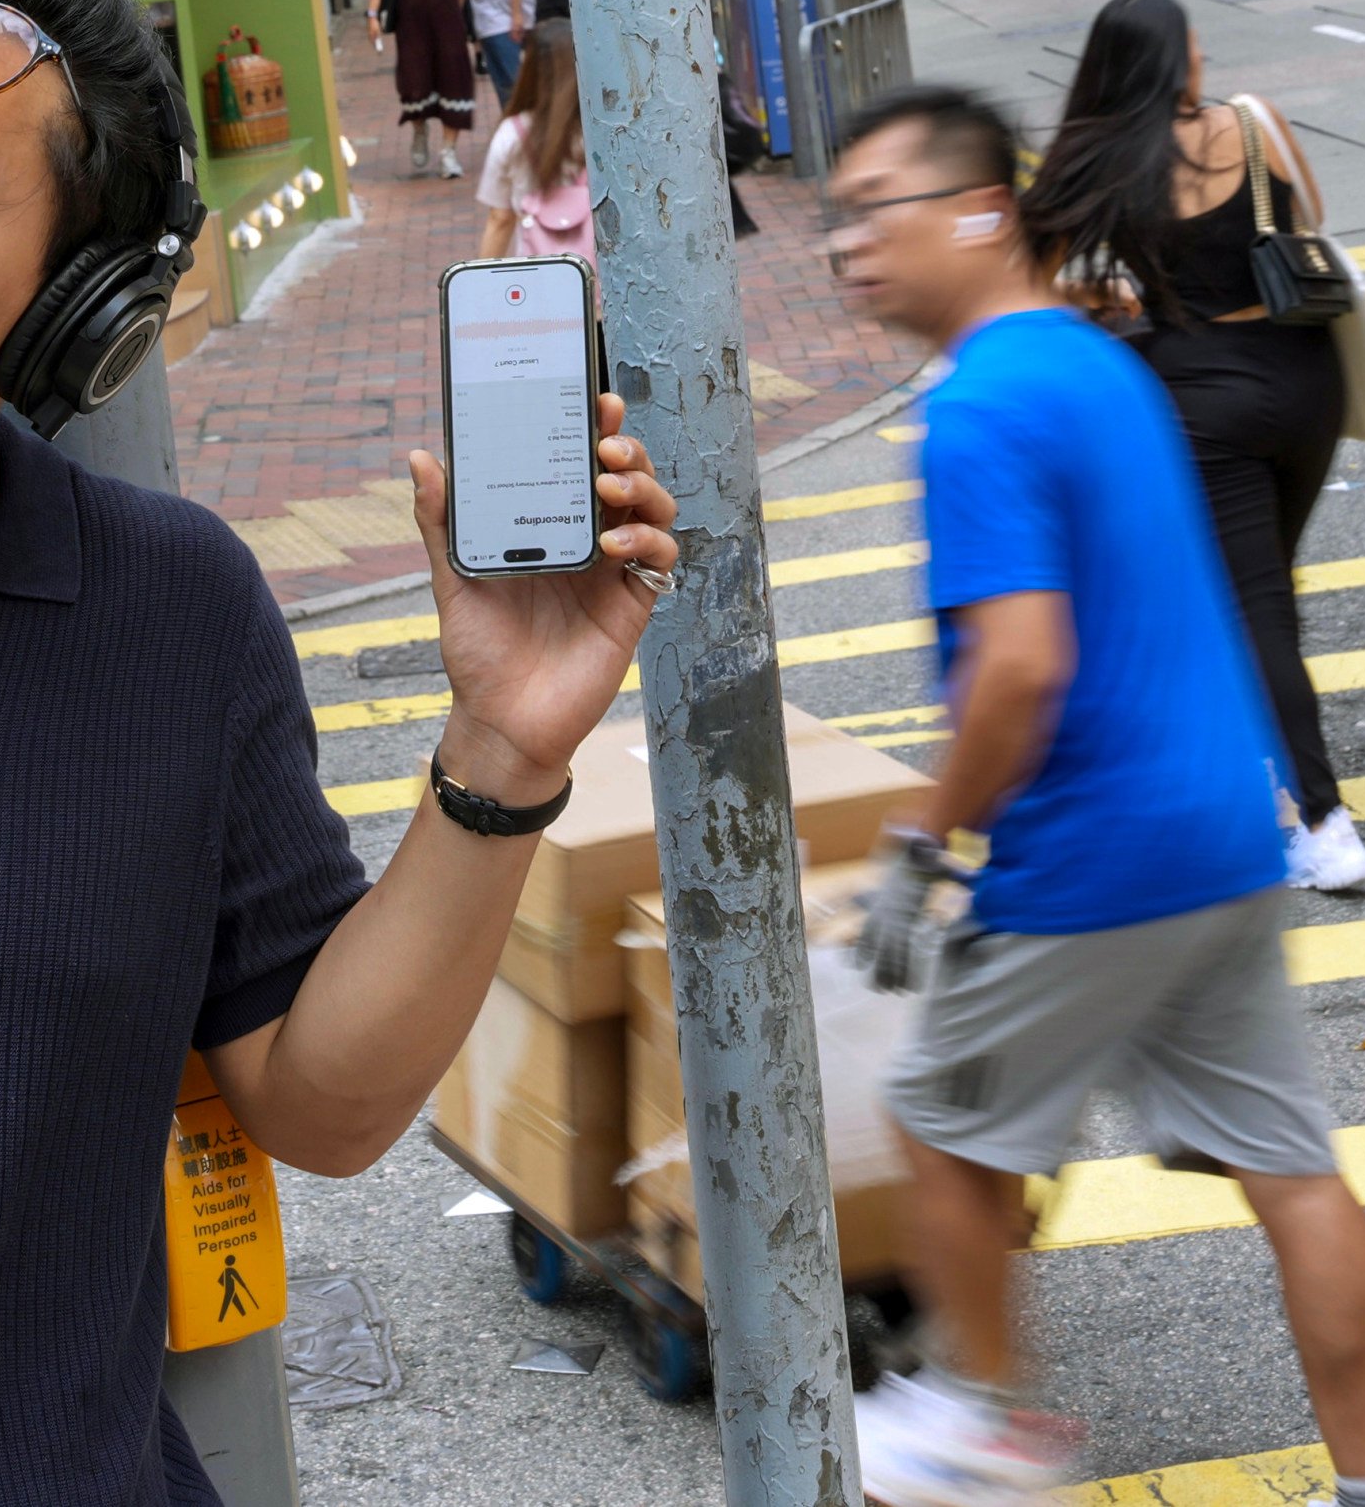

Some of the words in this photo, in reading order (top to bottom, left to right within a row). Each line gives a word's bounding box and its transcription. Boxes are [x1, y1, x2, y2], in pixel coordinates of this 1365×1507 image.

[514, 515, 571, 527] Recordings
[573, 514, 586, 524] All
[177, 1124, 242, 1157] 視障人士
[183, 1148, 248, 1179] 輔助設施
[191, 1181, 224, 1199] Aids
[227, 1173, 247, 1190] for
[193, 1194, 251, 1217] Visually
[193, 1210, 257, 1239] Impaired
[198, 1230, 258, 1255] Persons
